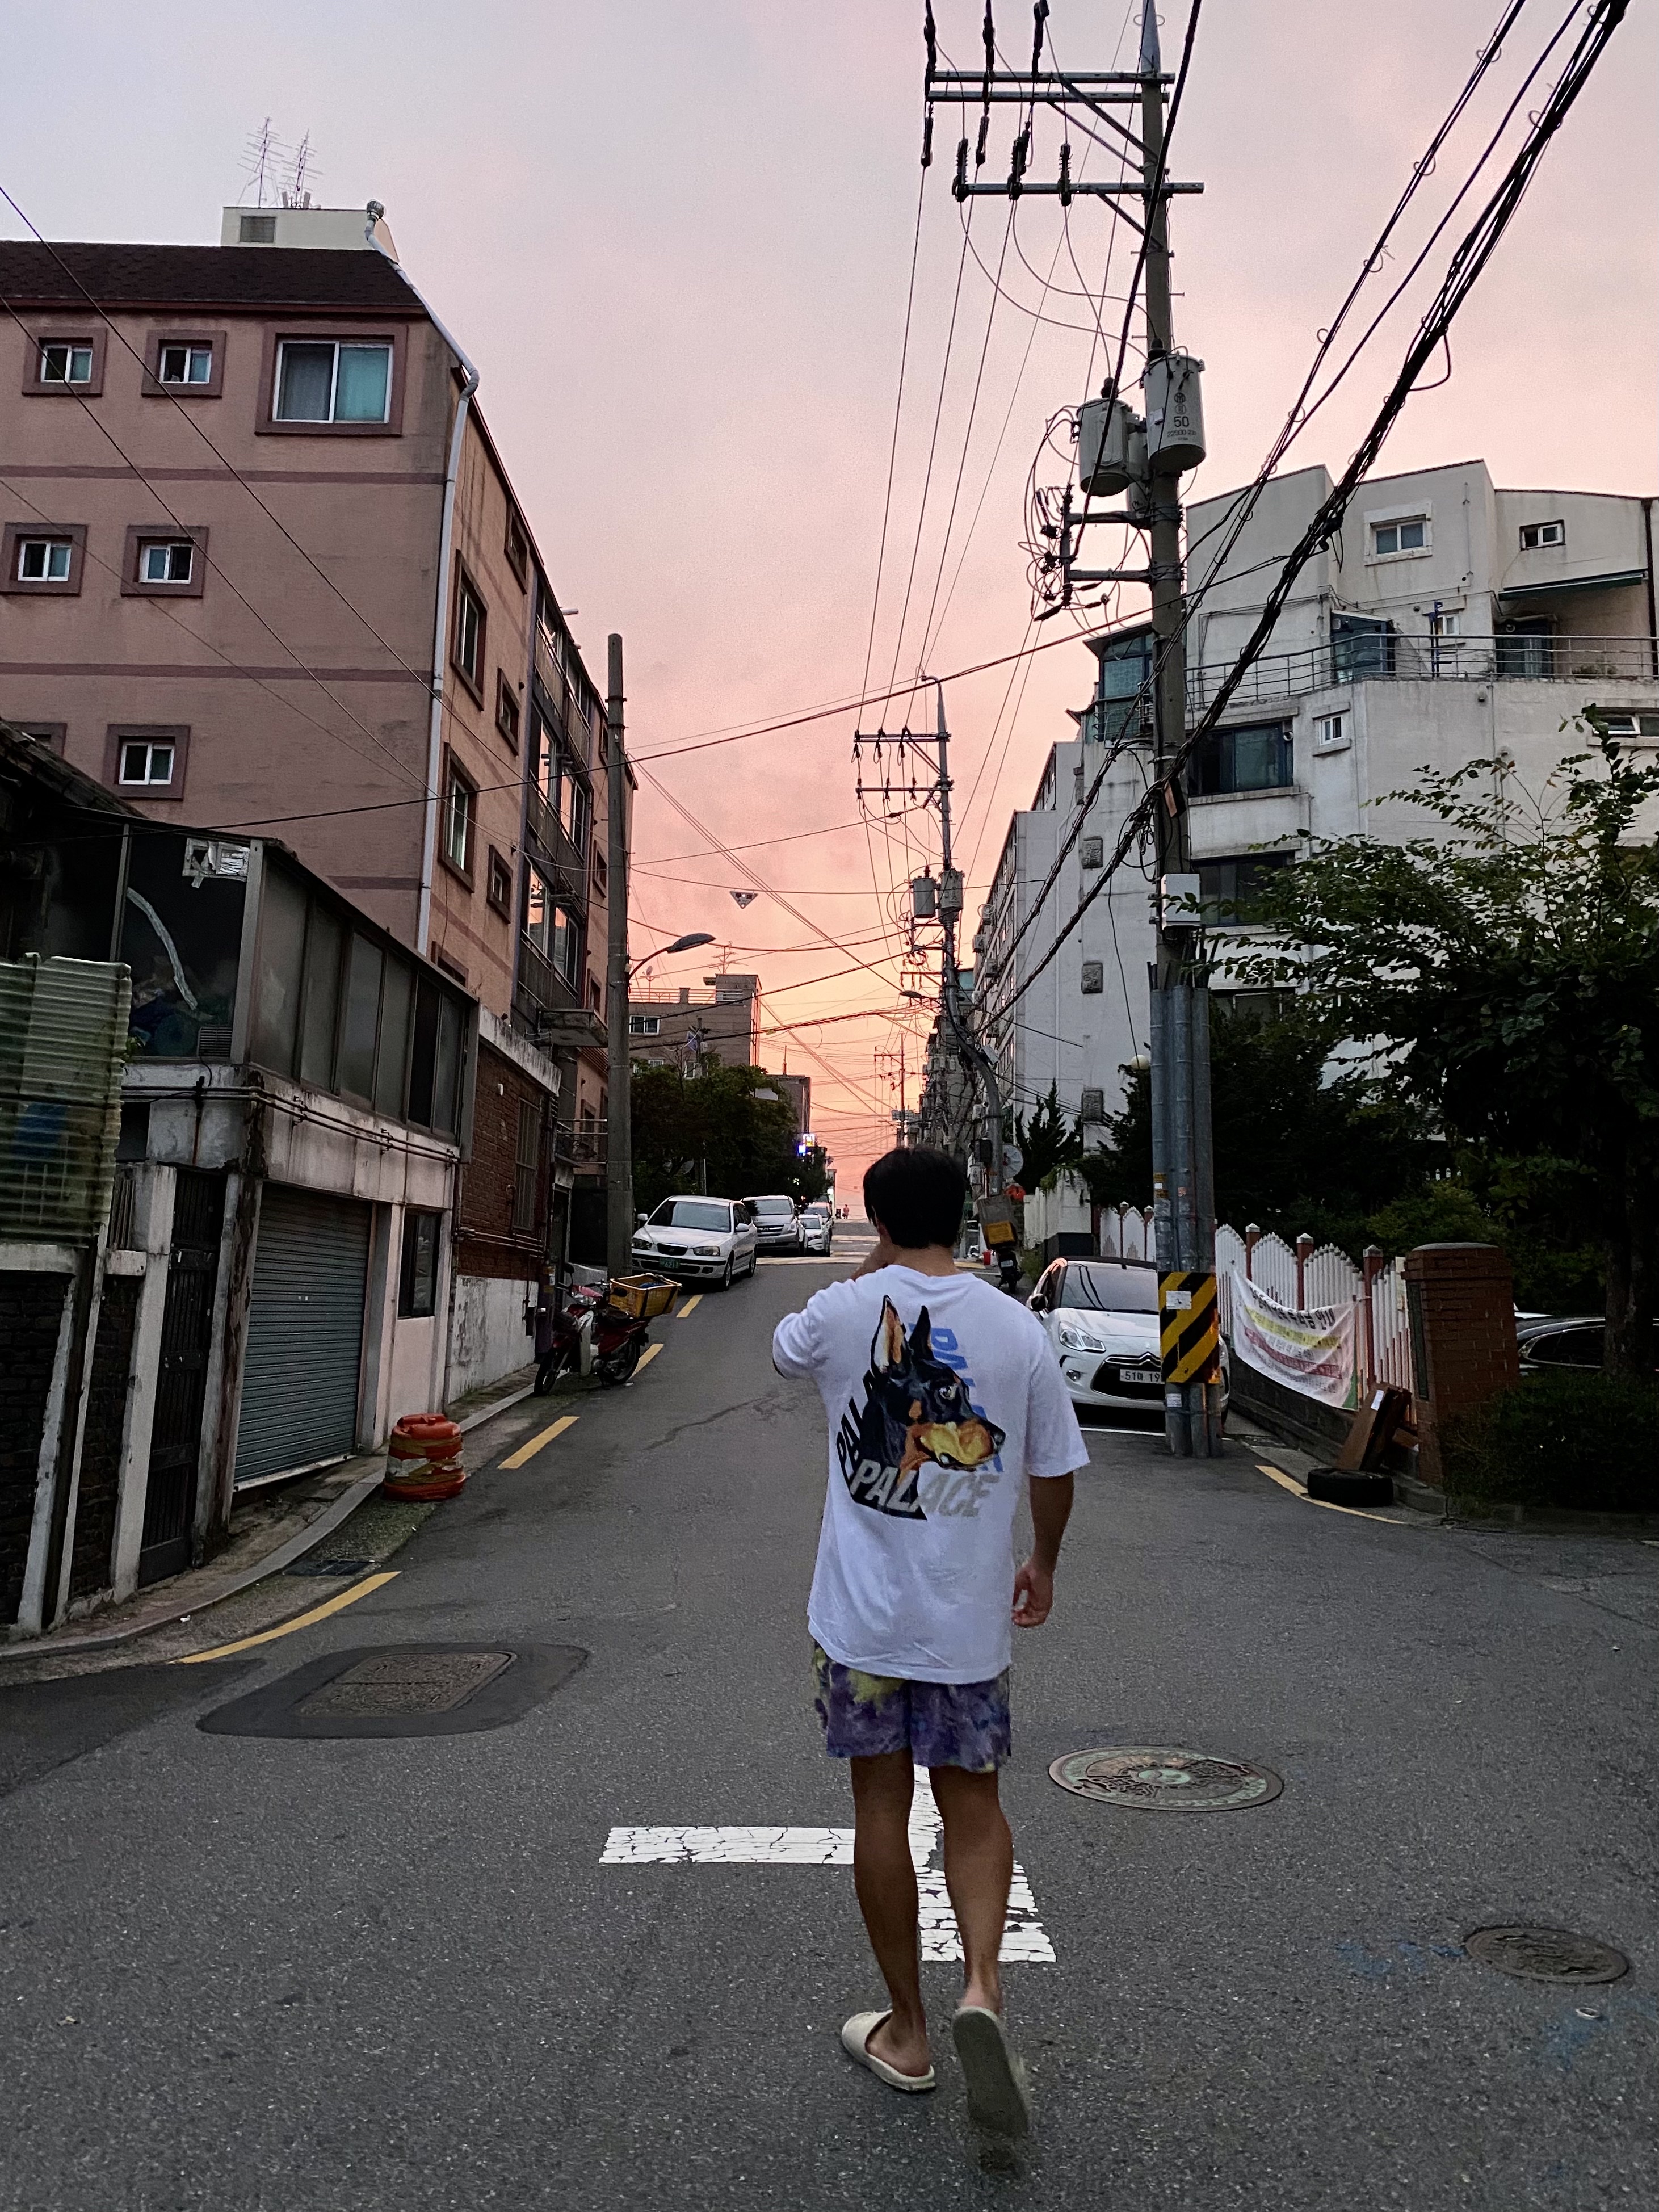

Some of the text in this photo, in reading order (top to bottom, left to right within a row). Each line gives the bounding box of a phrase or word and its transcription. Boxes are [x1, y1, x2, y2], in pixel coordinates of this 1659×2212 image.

[1174, 416, 1189, 427] 50
[1149, 1372, 1160, 1382] 19
[850, 1458, 999, 1517] PALACE
